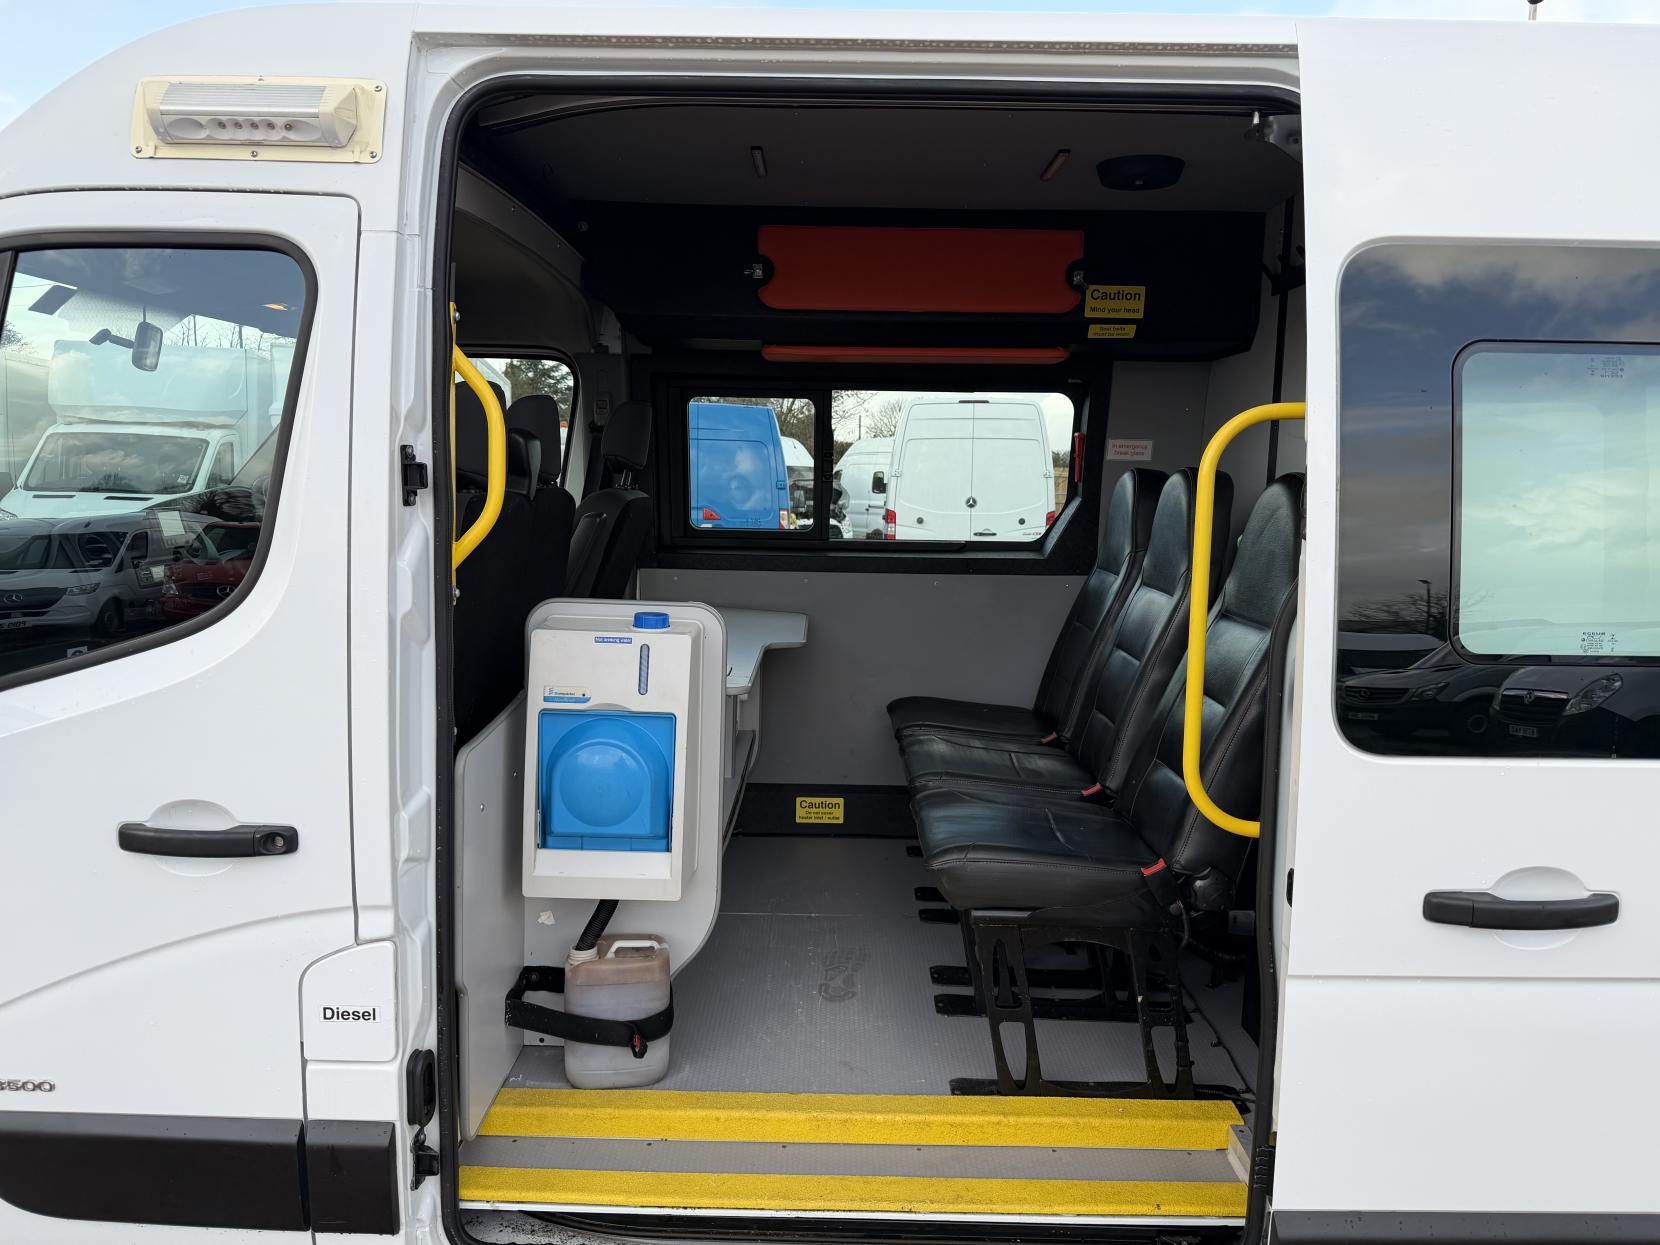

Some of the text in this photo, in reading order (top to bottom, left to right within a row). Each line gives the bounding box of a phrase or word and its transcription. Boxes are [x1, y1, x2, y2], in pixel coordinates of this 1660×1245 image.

[1091, 289, 1141, 300] Caution
[800, 800, 840, 809] Caution
[322, 1006, 377, 1021] Diesel
